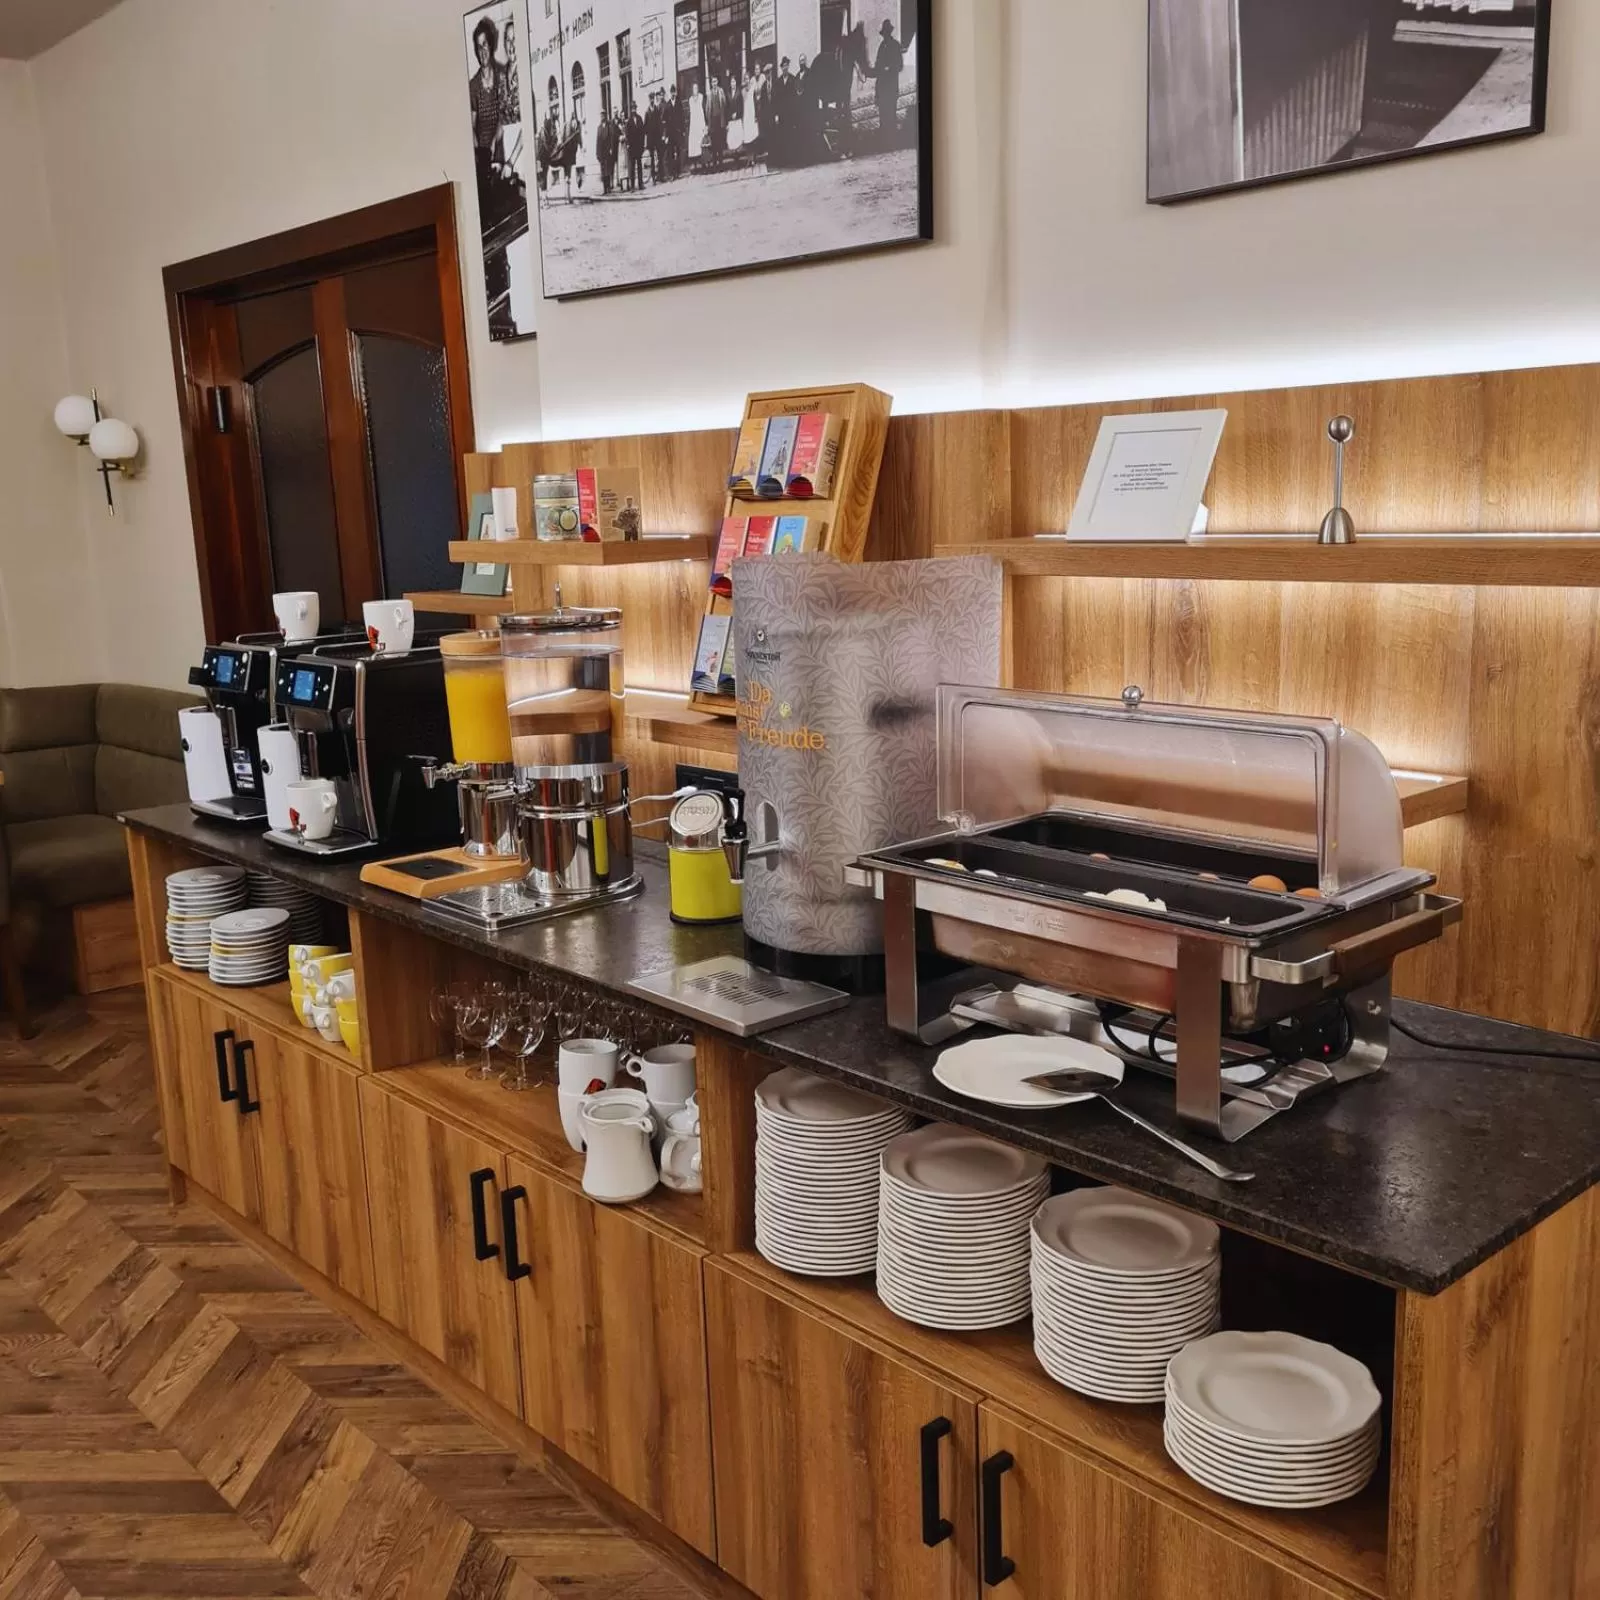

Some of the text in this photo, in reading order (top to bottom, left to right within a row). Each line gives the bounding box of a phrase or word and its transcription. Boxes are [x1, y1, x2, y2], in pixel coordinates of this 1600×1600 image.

[572, 6, 594, 39] HORN
[750, 681, 771, 705] Da
[747, 720, 825, 750] Freude
